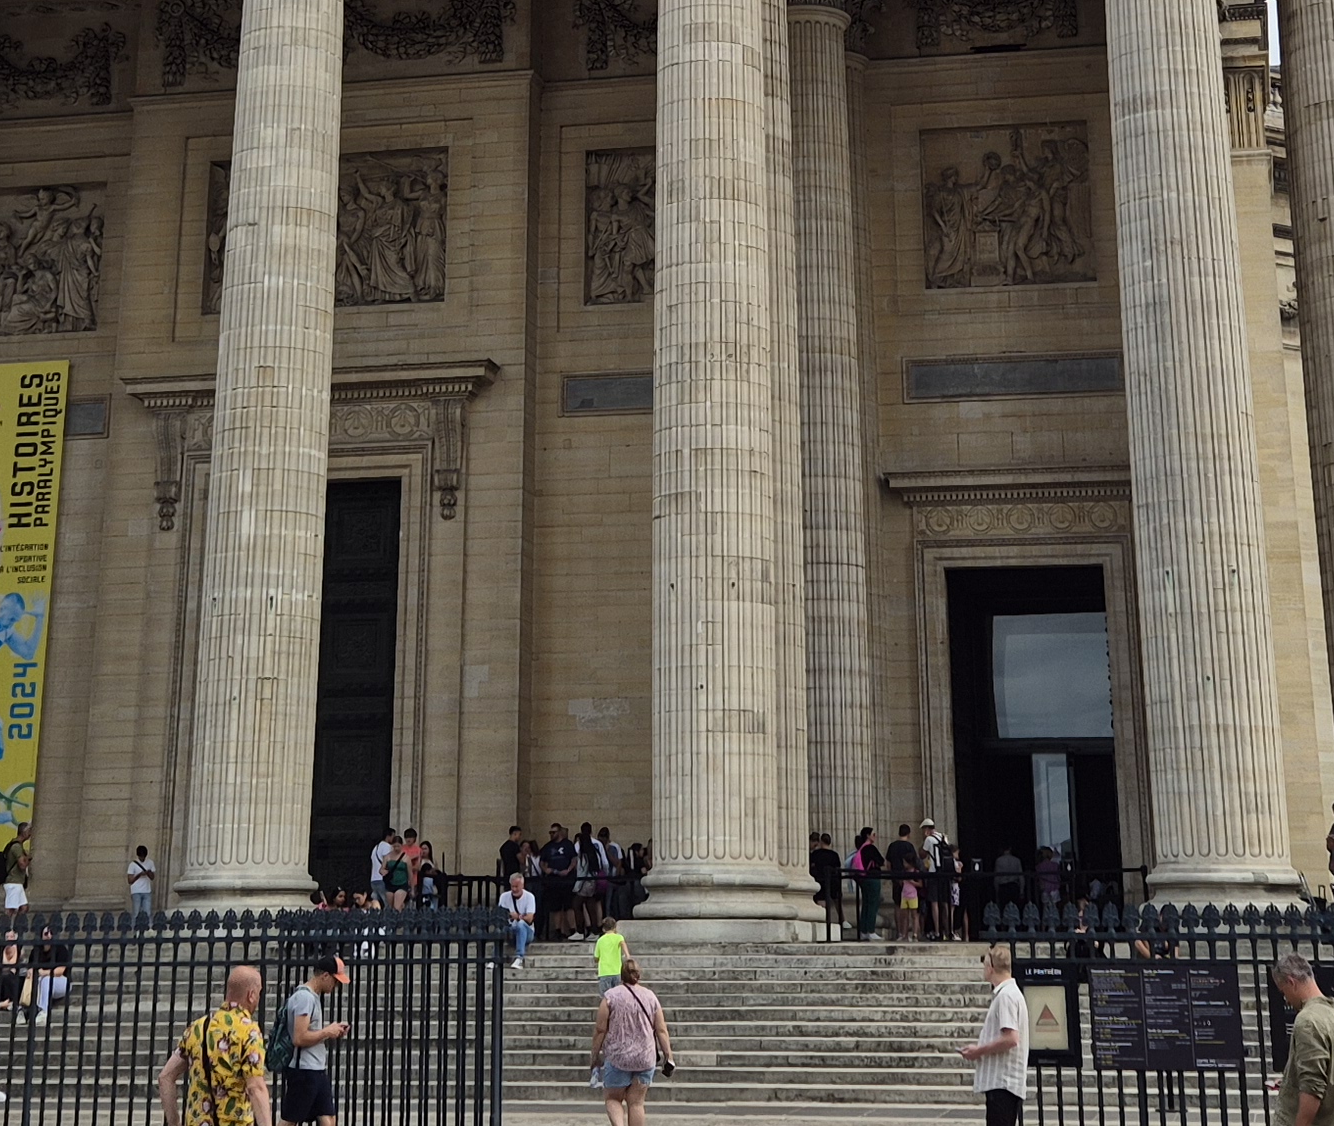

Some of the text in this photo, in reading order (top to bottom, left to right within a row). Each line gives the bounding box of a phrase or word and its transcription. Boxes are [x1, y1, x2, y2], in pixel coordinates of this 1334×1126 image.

[8, 374, 44, 528] HISTOIRES
[33, 372, 63, 527] PARALYMPIQUES
[8, 662, 38, 739] 2024
